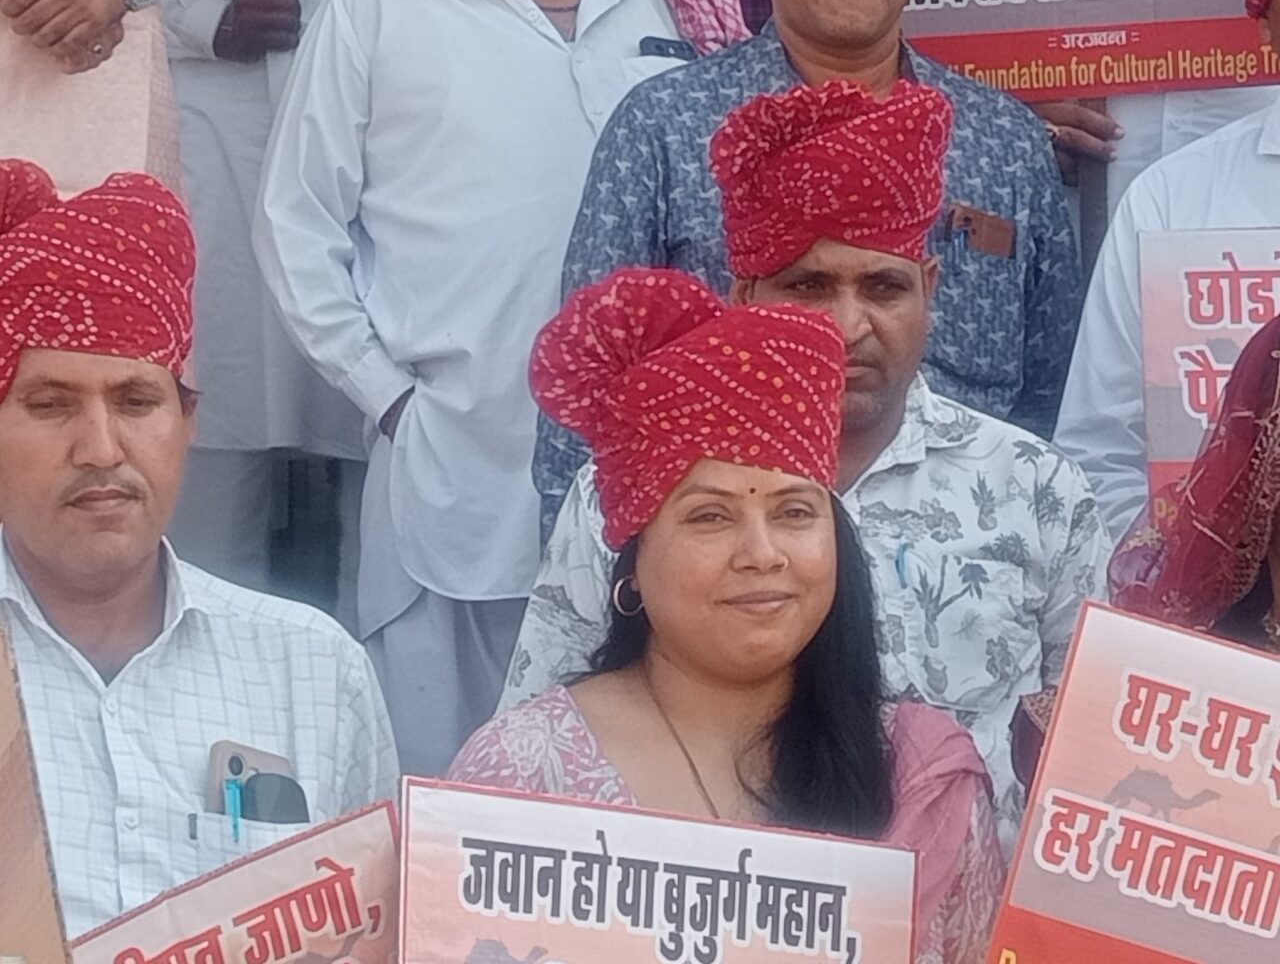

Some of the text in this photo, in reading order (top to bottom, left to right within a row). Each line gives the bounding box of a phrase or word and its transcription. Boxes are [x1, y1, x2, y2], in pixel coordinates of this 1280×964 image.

[1070, 58, 1097, 86] for
[1100, 50, 1174, 84] Cultural
[1177, 48, 1258, 81] Heritage
[1119, 674, 1271, 779] घर-घर
[1042, 795, 1109, 876] हर
[232, 857, 381, 964] जाणो,
[462, 830, 857, 964] जवान हो या बुजुर्ग महान,
